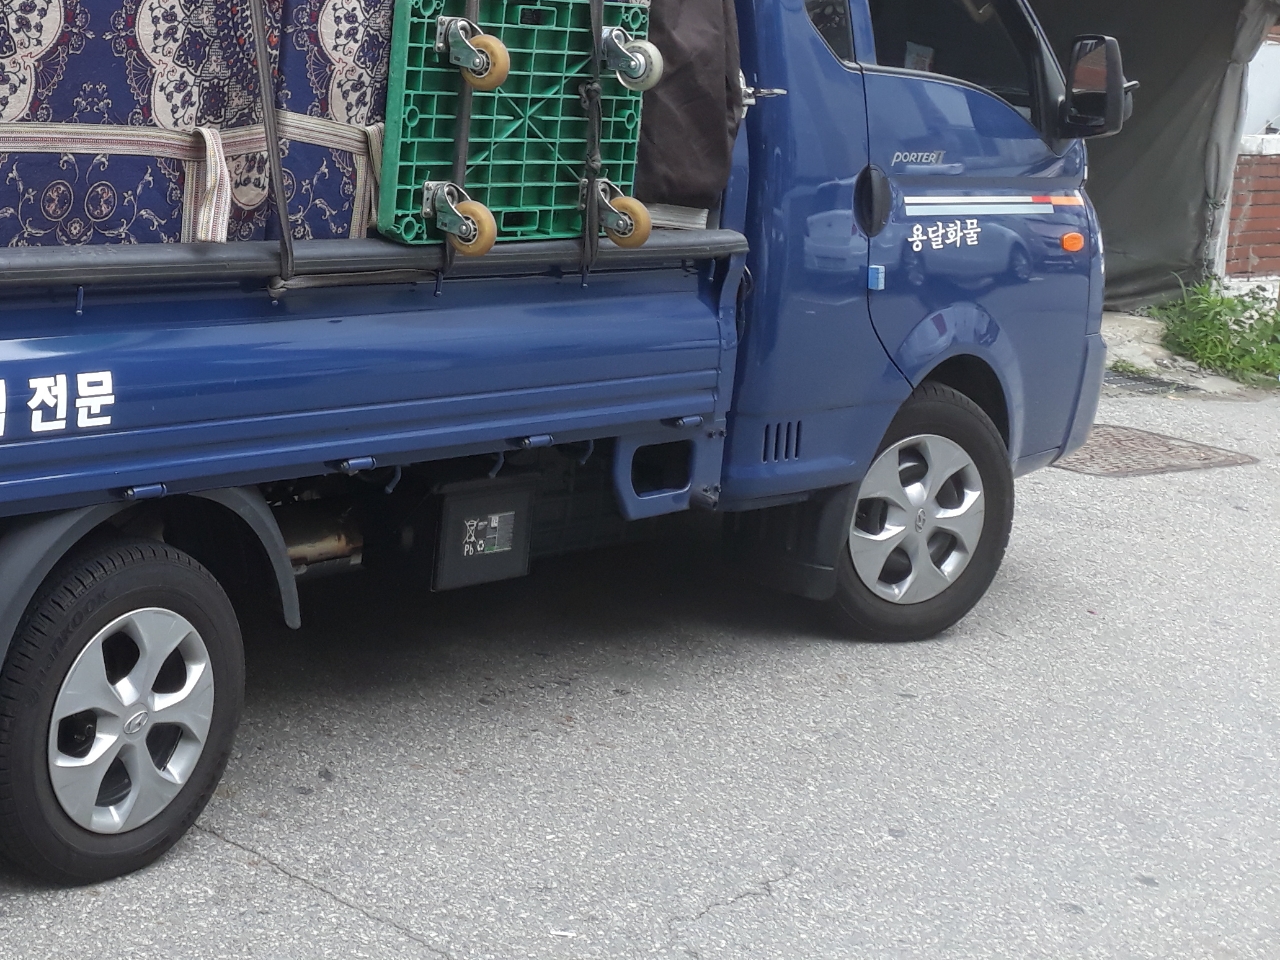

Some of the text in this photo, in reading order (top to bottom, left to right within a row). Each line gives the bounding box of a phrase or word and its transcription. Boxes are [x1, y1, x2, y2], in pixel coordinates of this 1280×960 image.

[907, 219, 982, 252] 용달화물
[27, 370, 116, 433] 전문
[463, 544, 474, 556] Pb
